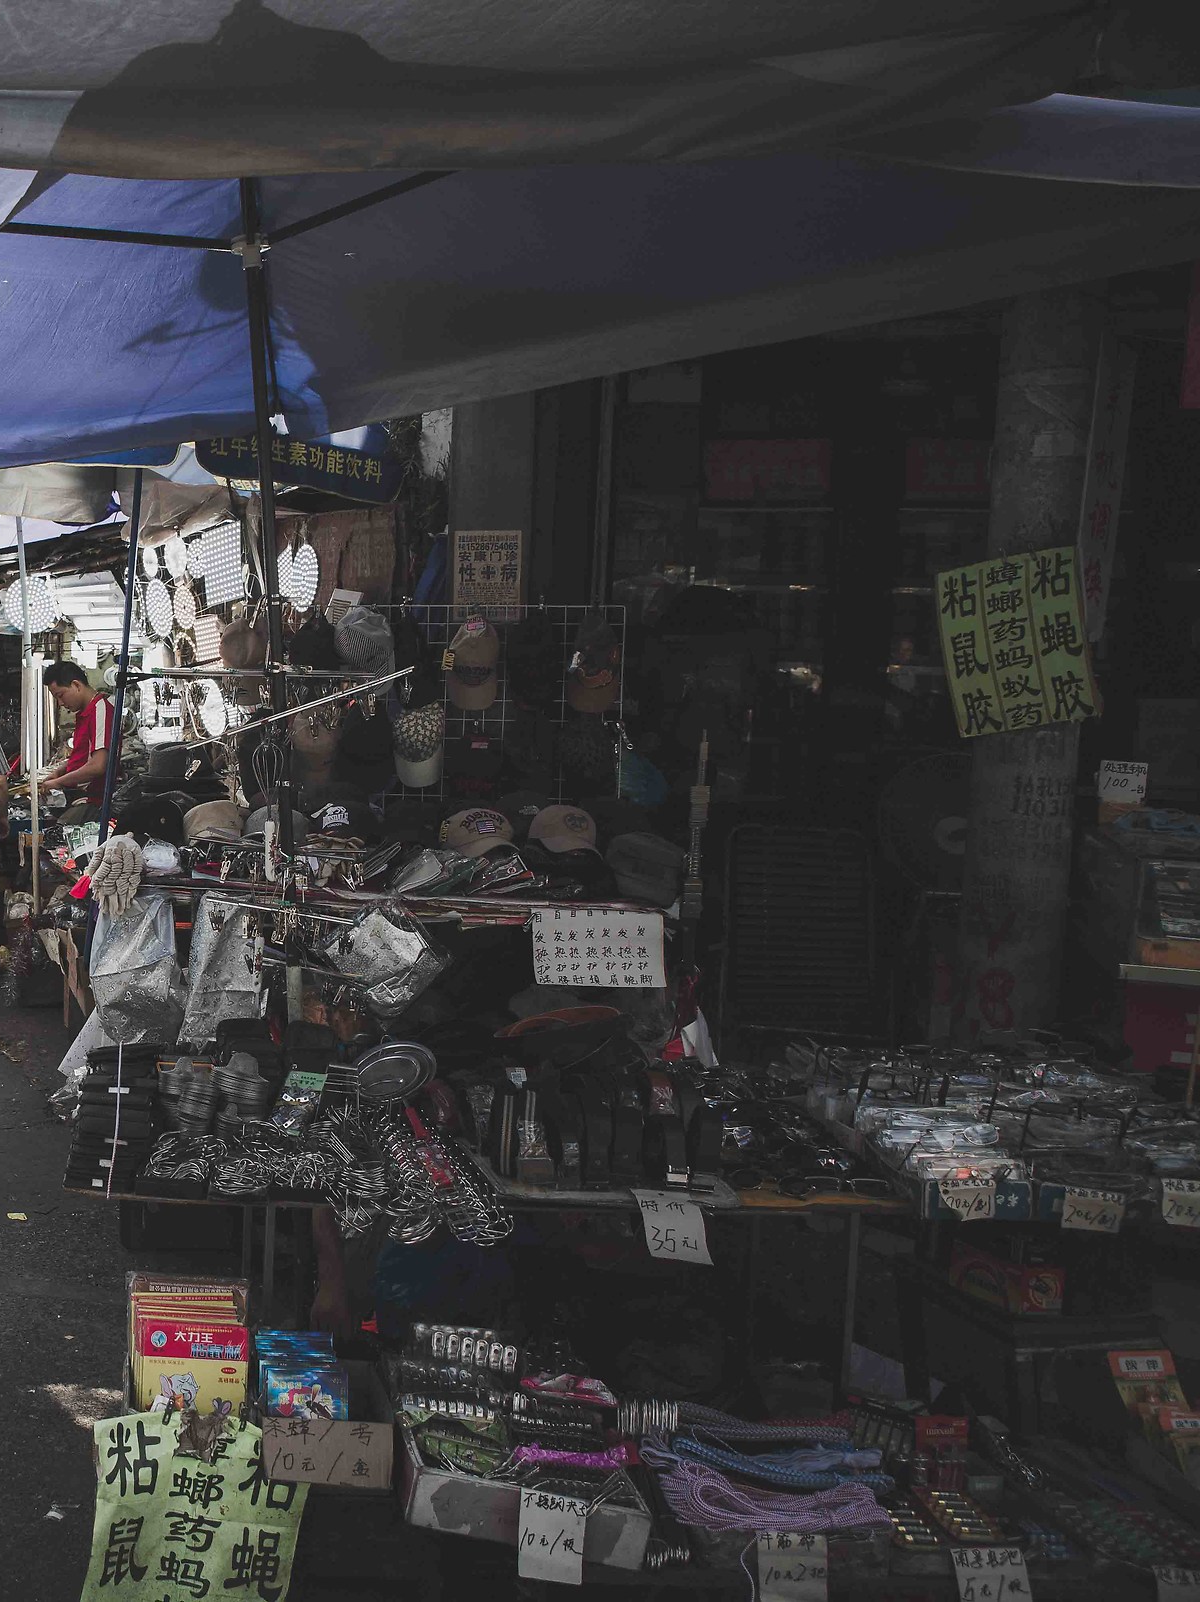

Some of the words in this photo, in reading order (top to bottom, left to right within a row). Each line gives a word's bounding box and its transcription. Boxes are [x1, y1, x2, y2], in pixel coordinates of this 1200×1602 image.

[942, 572, 1004, 735] 粘鼠胶
[985, 562, 1042, 728] 蟑螂药蚂蚁药
[1031, 552, 1095, 720] 粘蝇胶
[651, 1225, 698, 1253] 35元
[173, 1331, 214, 1344] 大力王
